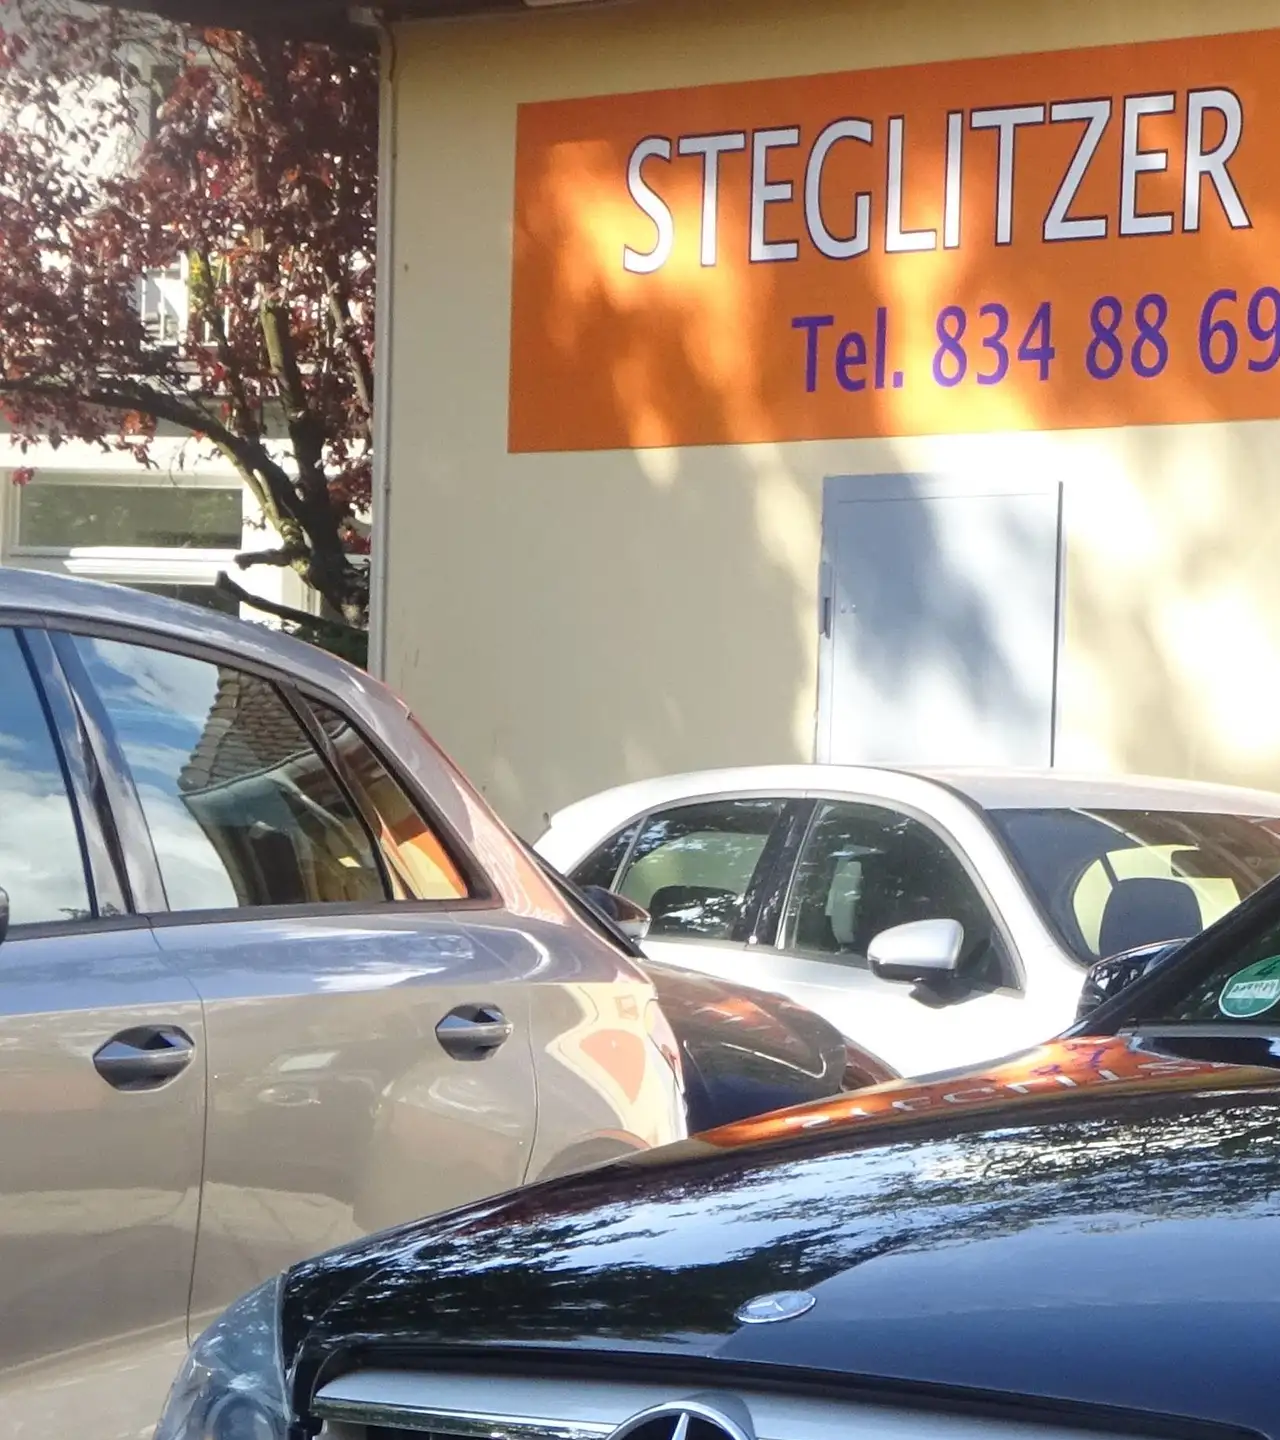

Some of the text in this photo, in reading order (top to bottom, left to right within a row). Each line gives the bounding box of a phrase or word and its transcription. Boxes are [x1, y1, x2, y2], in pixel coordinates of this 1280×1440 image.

[622, 86, 1252, 275] STEGLITZER
[791, 307, 903, 393] Tel.
[931, 300, 1057, 388] 834
[1085, 292, 1169, 381] 88
